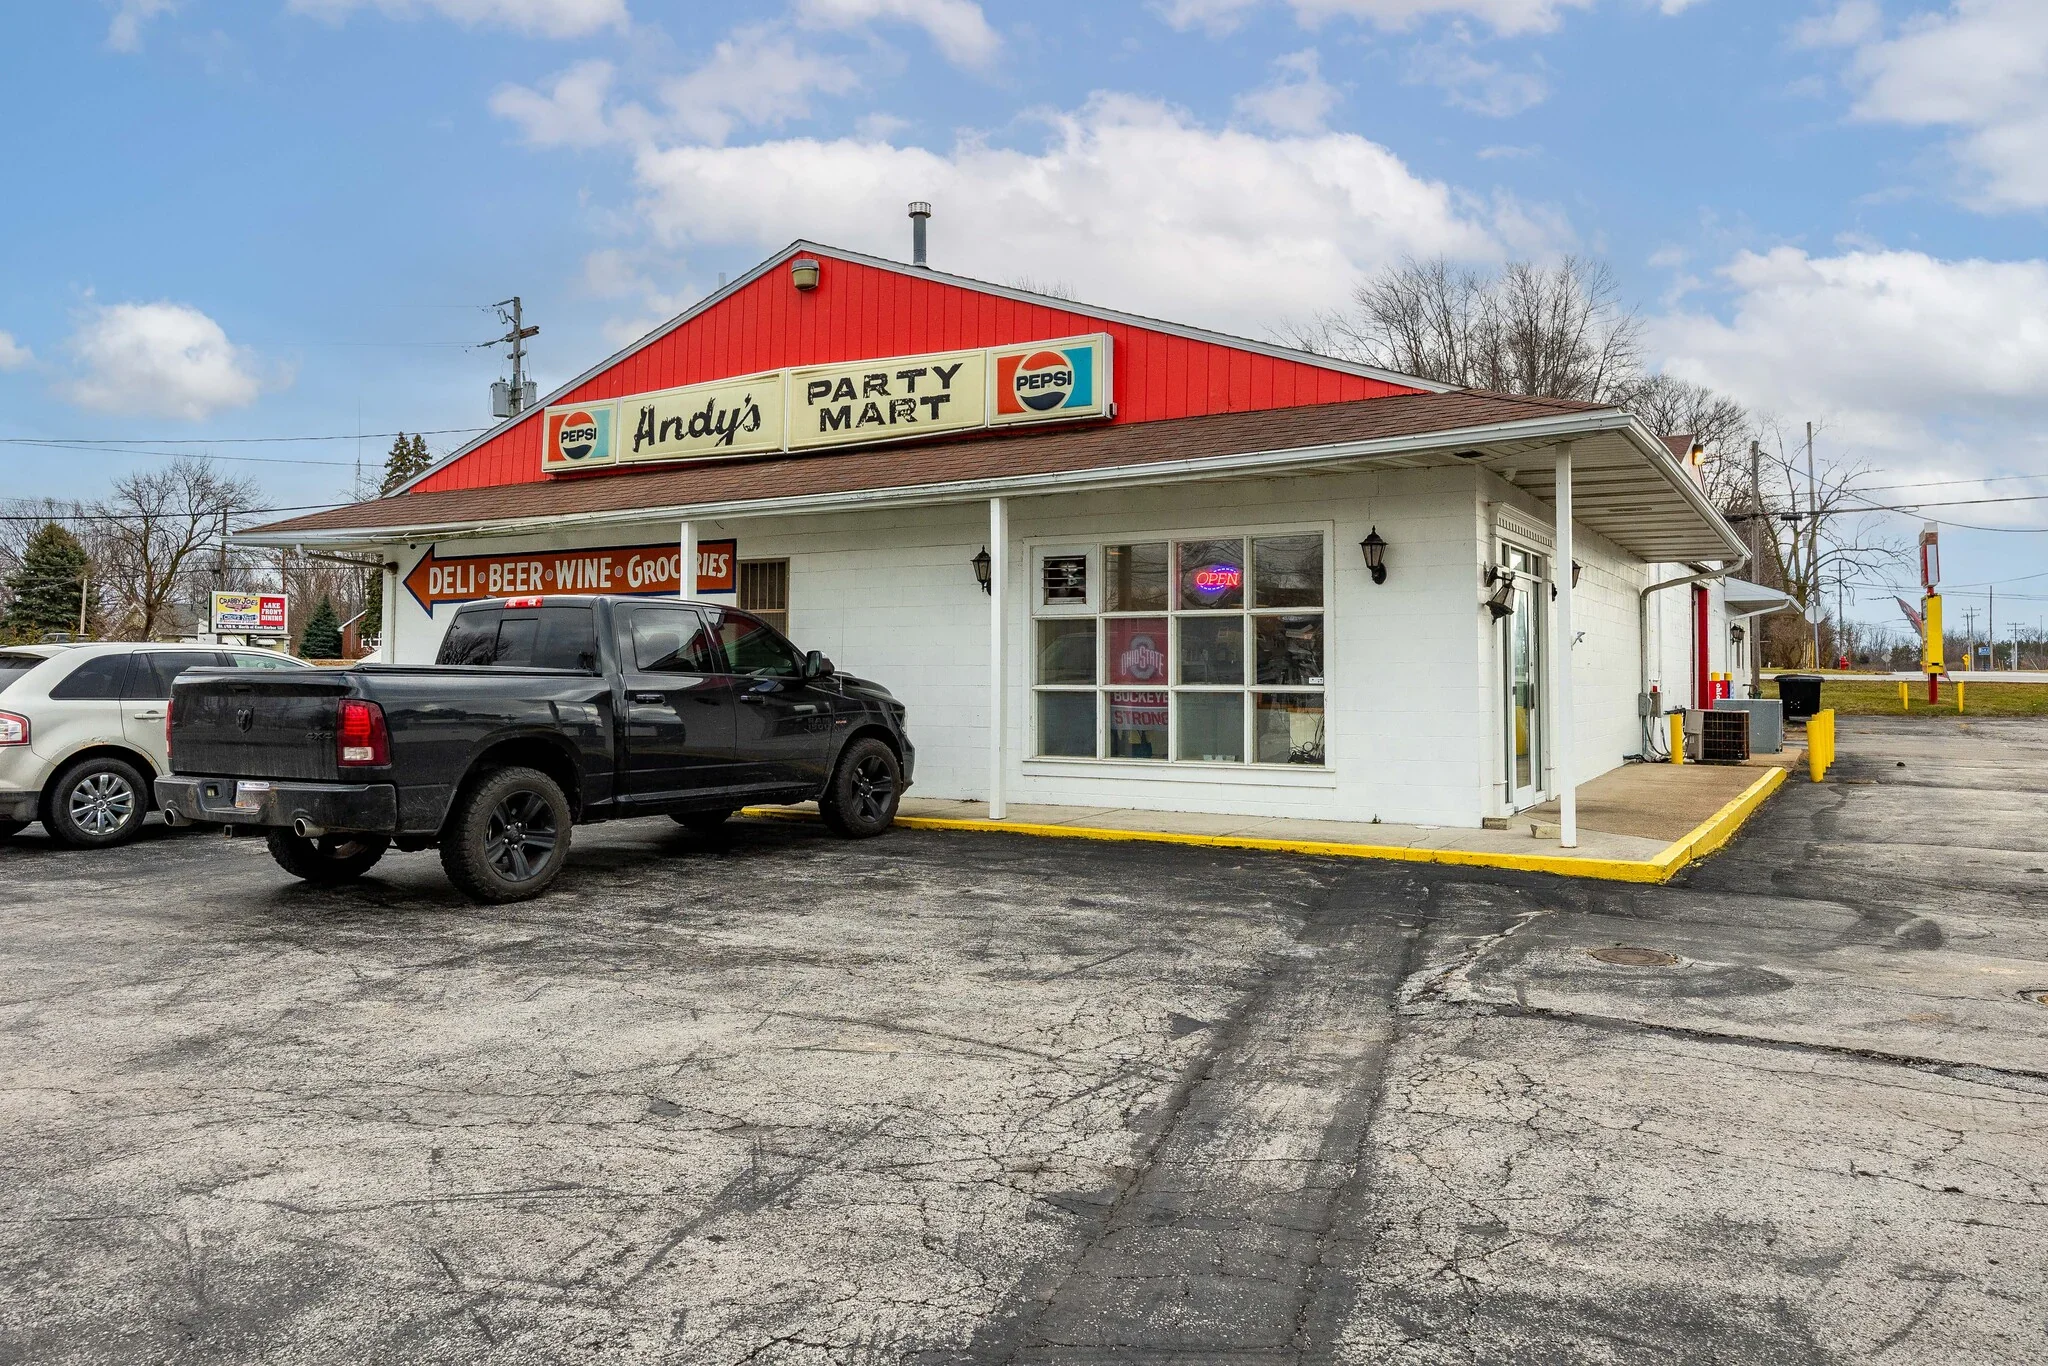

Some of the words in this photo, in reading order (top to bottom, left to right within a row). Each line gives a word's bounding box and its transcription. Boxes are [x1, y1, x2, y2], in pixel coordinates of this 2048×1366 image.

[808, 362, 963, 406] PARTY
[1016, 370, 1072, 391] PEPSI
[633, 393, 761, 453] Andy's
[819, 393, 951, 432] MART
[561, 427, 597, 444] PEPSI
[428, 564, 475, 595] DELI
[488, 561, 543, 593] BEER
[555, 557, 612, 590] WINE
[627, 552, 730, 588] GROCRIES
[1196, 571, 1239, 586] OPEN
